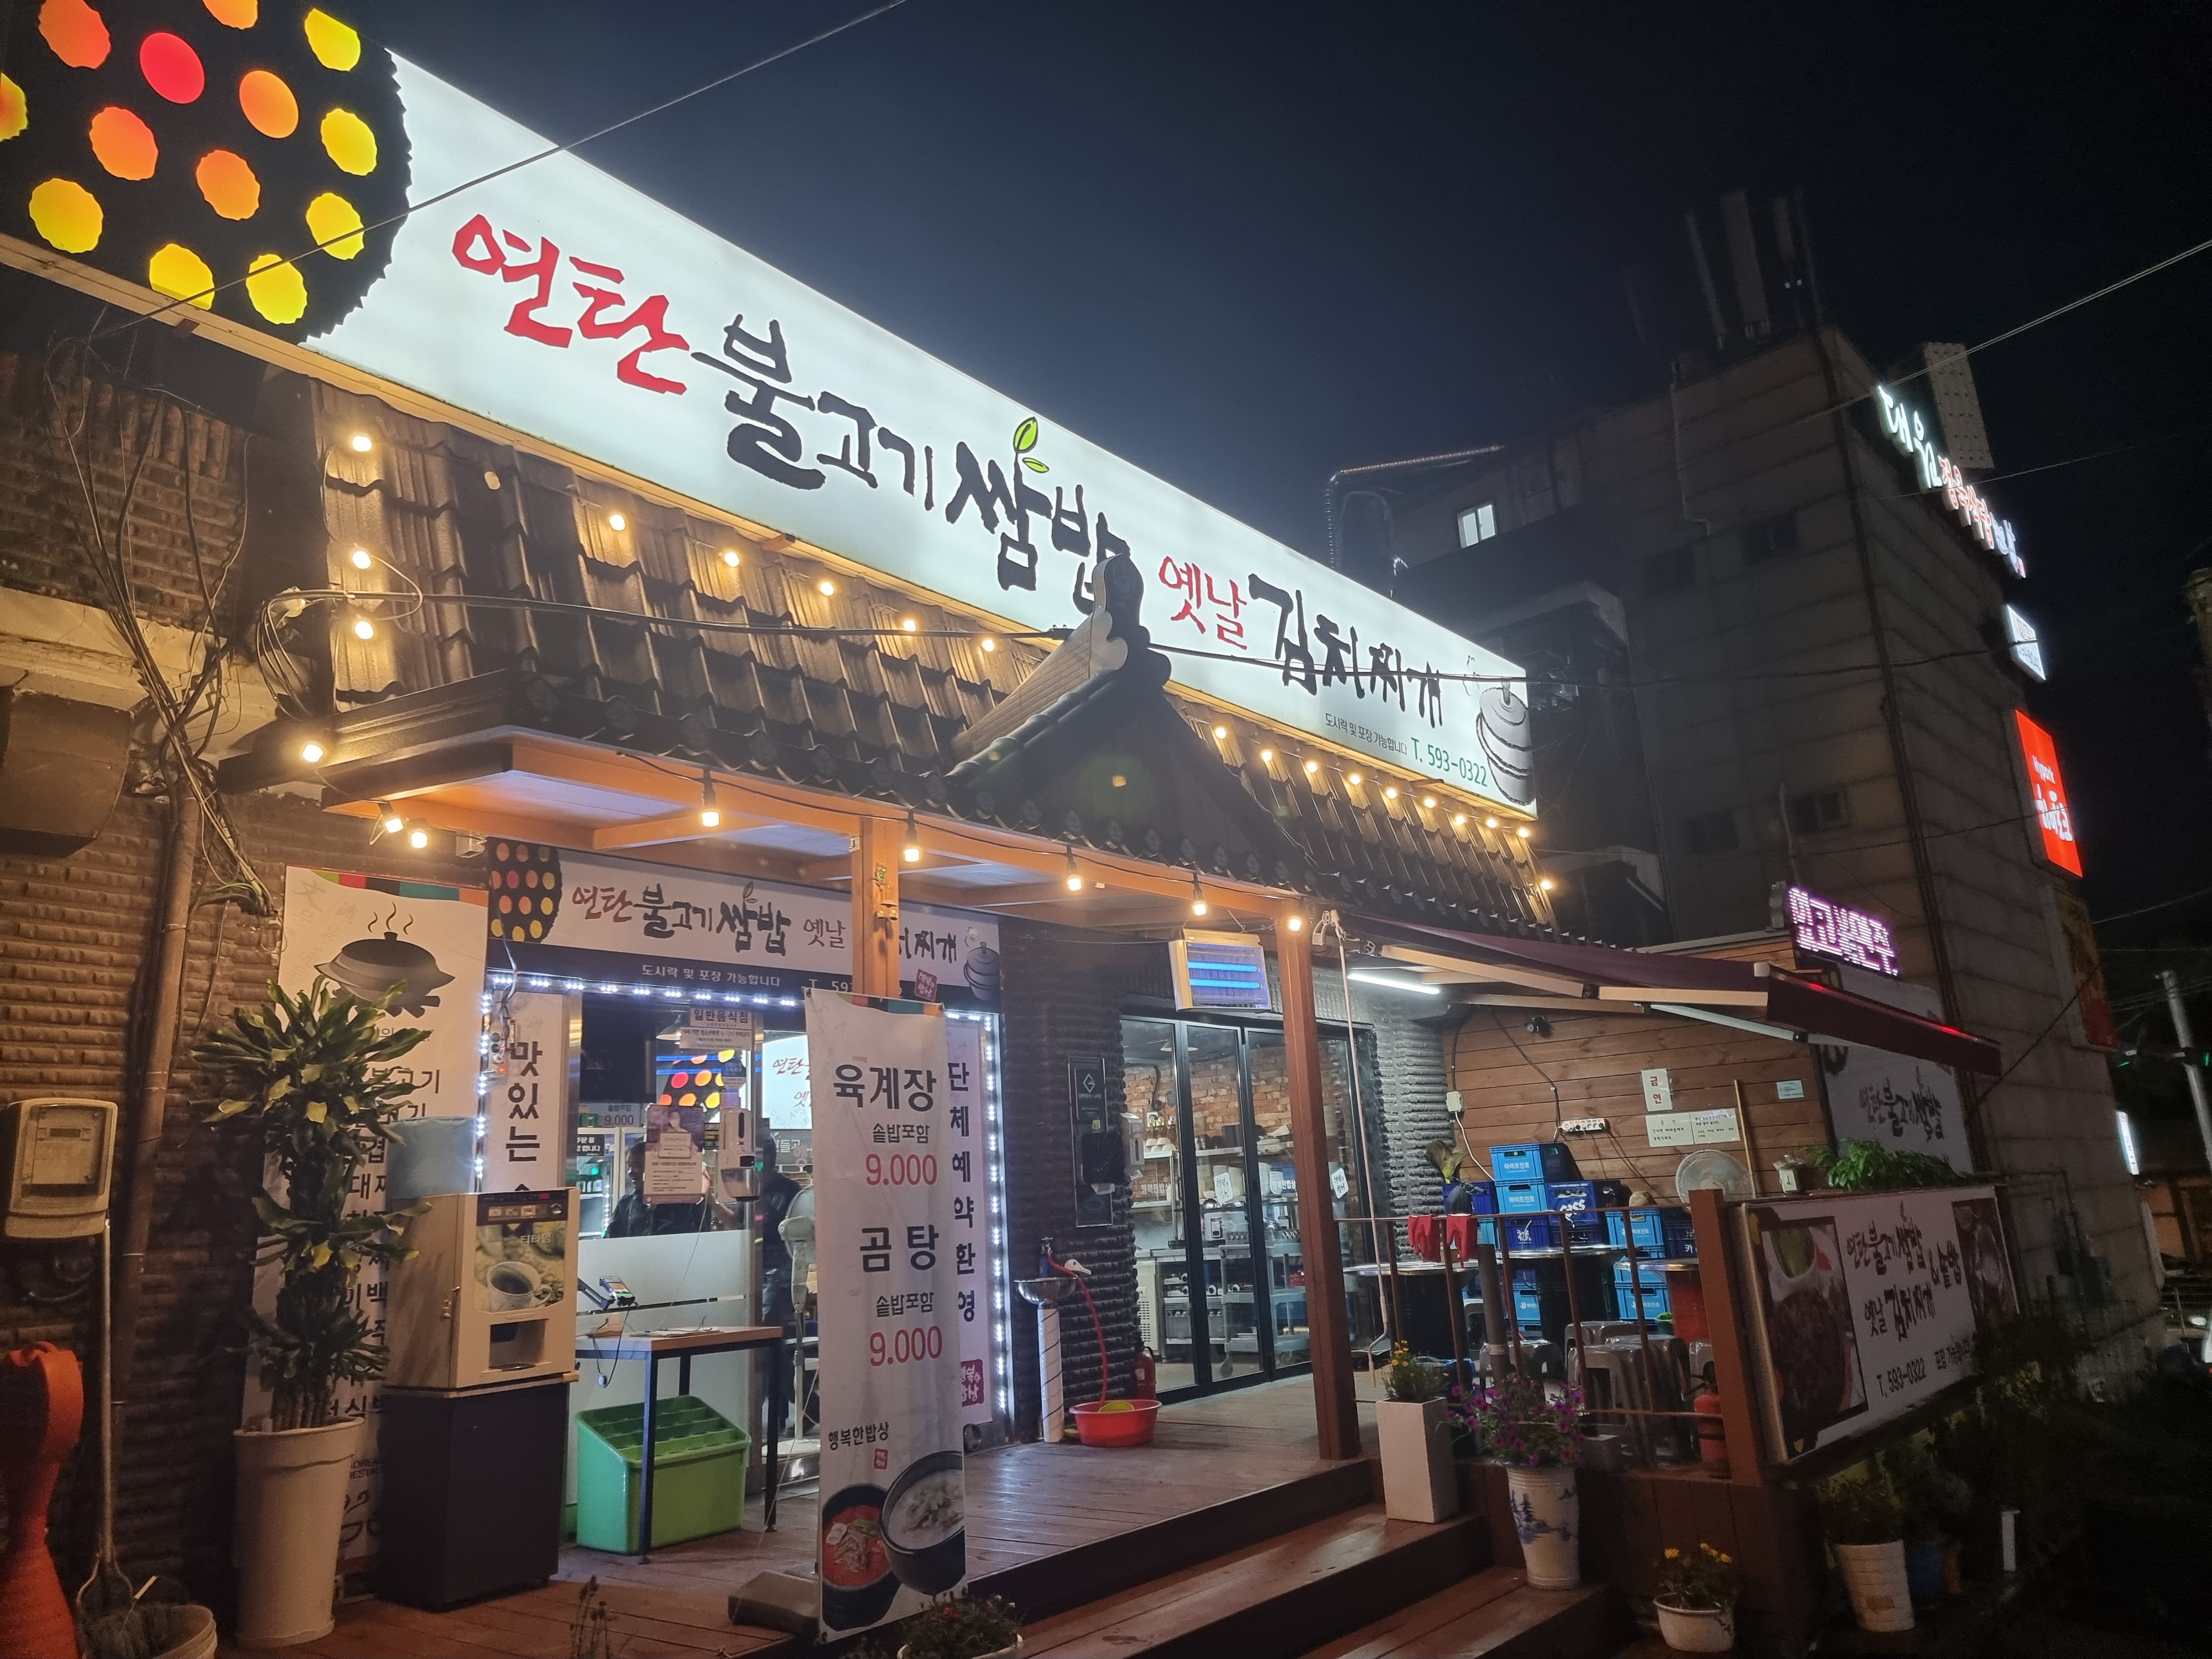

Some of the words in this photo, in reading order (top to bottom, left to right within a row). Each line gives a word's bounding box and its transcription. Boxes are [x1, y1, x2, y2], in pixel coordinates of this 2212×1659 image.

[1159, 556, 1246, 649] 옛날
[1249, 574, 1442, 728] 김치찌개
[1326, 713, 1348, 733] 도시락
[1349, 720, 1357, 737] 및
[1358, 726, 1373, 743] 포장
[1374, 732, 1407, 755] 가능합니다
[1428, 744, 1488, 787] 593-0322
[804, 919, 846, 948] 옛날
[643, 965, 679, 978] 도시락
[684, 969, 693, 979] 및
[700, 970, 721, 982] 포장
[726, 973, 780, 987] 가능합니다
[694, 1009, 748, 1023] 일반음식점
[505, 1041, 542, 1162] 맛있는
[833, 1064, 937, 1112] 육계장
[1650, 1076, 1662, 1104] 금연
[604, 1115, 634, 1125] 9.000
[873, 1123, 930, 1144] 솥밥포함
[865, 1153, 937, 1186] 9.000
[1272, 1179, 1296, 1190] 행복한밥상
[520, 1232, 551, 1244] 티타임
[876, 1291, 934, 1318] 솥밥포함
[869, 1326, 942, 1367] 9.000
[1887, 1357, 1927, 1393] 593-0322
[827, 1421, 890, 1451] 행복한밥상
